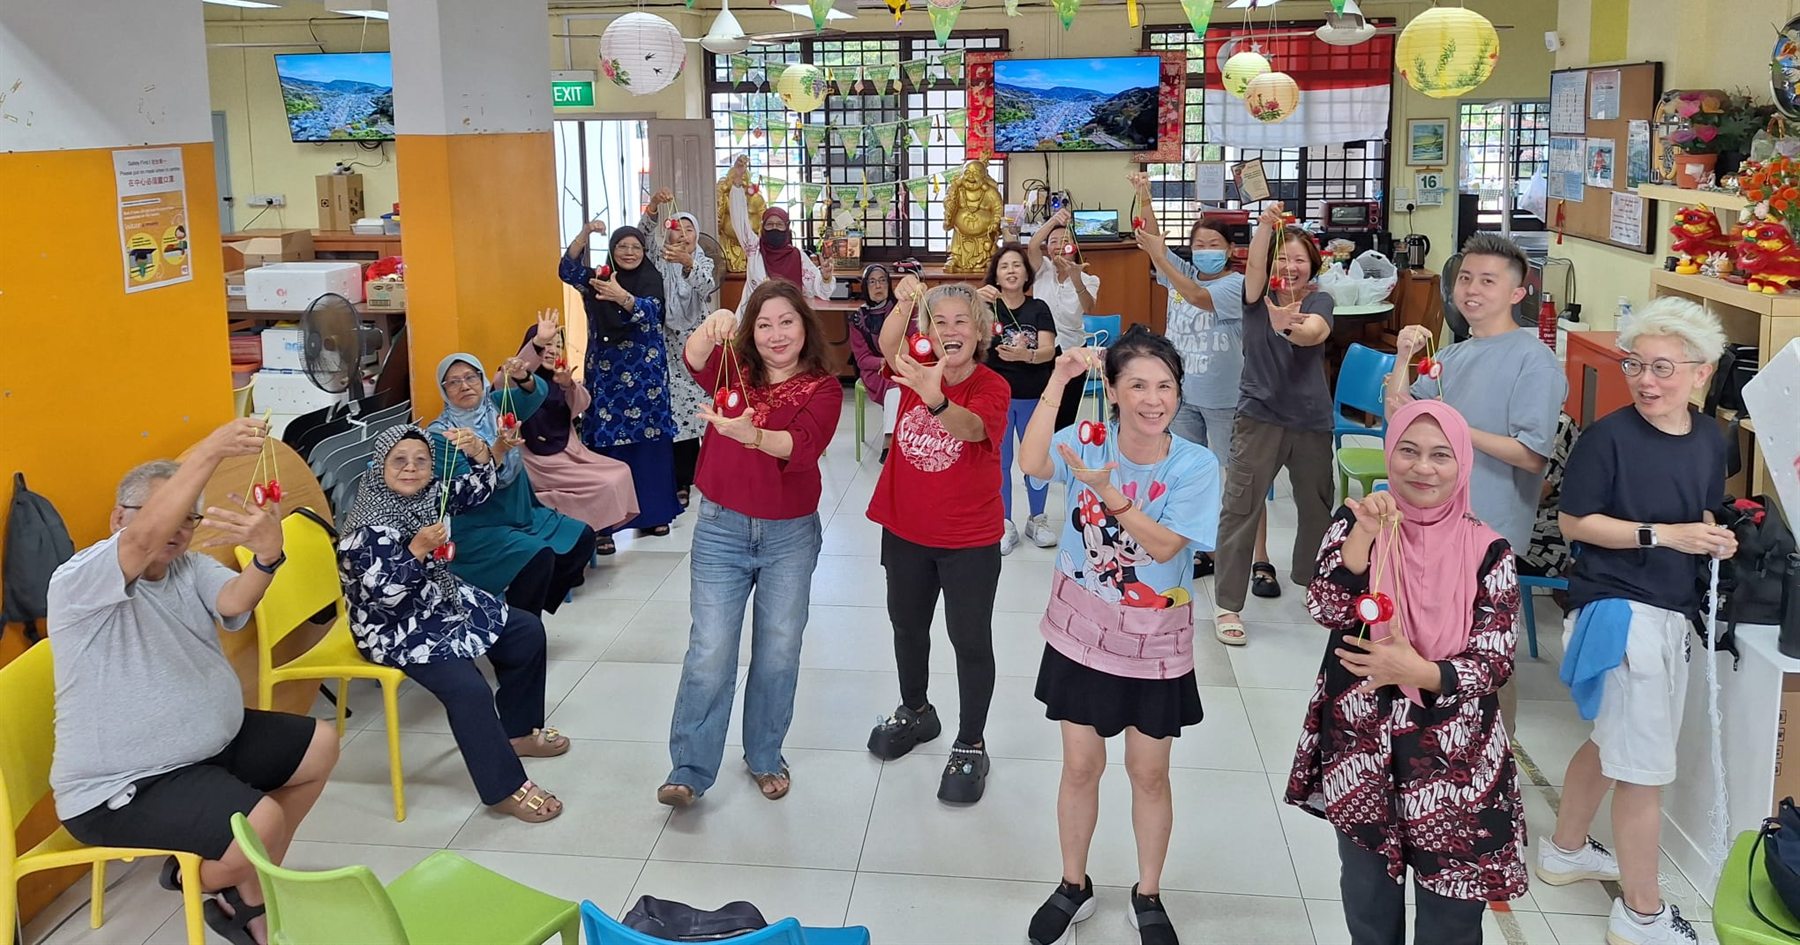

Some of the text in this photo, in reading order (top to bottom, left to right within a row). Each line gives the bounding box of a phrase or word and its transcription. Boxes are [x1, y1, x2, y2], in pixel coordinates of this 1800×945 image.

[554, 86, 582, 102] EXIT
[1421, 175, 1437, 189] 16
[1212, 331, 1230, 352] IS
